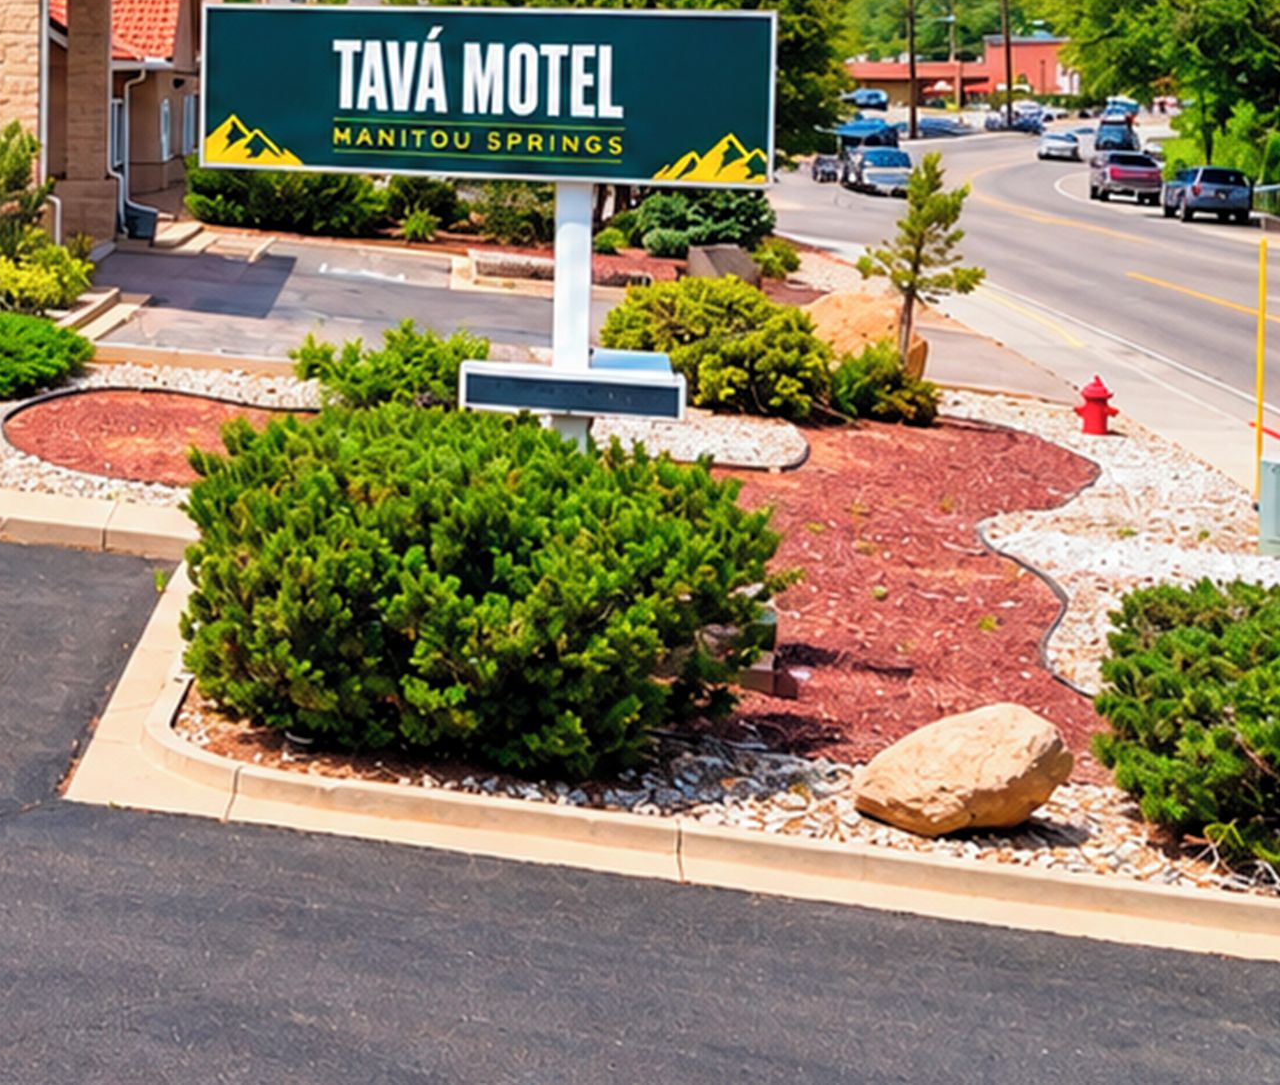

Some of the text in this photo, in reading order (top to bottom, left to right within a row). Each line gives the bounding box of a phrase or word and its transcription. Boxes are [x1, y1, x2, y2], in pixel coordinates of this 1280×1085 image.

[332, 25, 624, 119] TAVÁ MOTEL
[332, 127, 623, 155] MANITOU SPRINGS
